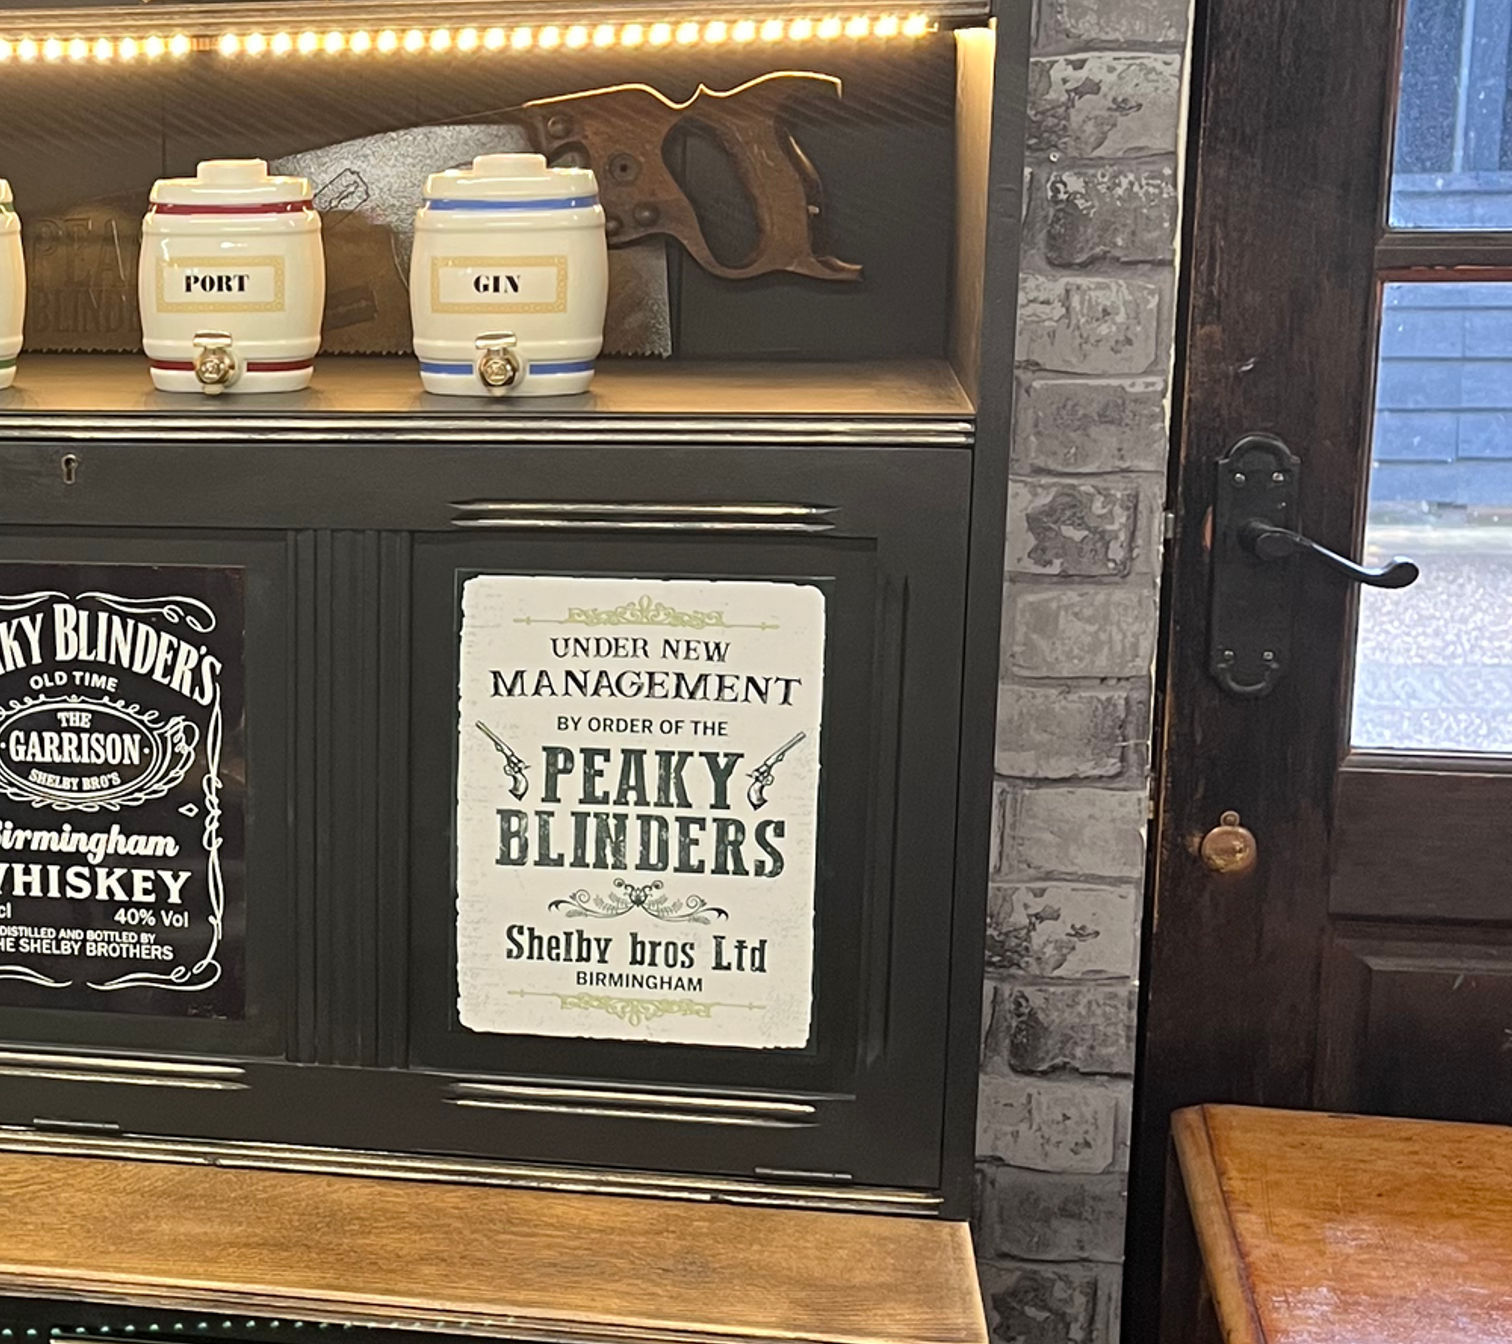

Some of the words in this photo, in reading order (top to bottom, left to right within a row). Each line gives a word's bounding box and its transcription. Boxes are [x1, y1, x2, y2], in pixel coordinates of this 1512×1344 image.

[184, 274, 250, 294] PORT
[473, 274, 522, 294] GIN
[53, 603, 222, 706] BLINDER'S
[550, 637, 649, 659] UNDER
[662, 639, 730, 663] NEW
[29, 671, 68, 690] OLD
[72, 671, 119, 693] TIME
[489, 669, 802, 706] MANAGEMENT
[57, 711, 92, 728] THE
[557, 716, 582, 731] BY
[588, 717, 653, 733] ORDER
[660, 719, 685, 734] OF
[690, 720, 728, 736] THE
[9, 731, 141, 765] GARRISON
[28, 768, 79, 790] SHELBY
[81, 771, 121, 791] BRO'S
[541, 745, 745, 810] PEAKY
[495, 808, 786, 878] BLINDERS
[114, 908, 156, 926] 40%
[160, 910, 189, 928] Vol
[0, 925, 56, 939] DISTILLED
[58, 928, 84, 940] AND
[87, 929, 138, 943] BOTTLED
[140, 932, 155, 944] BY
[19, 937, 82, 956] SHELBY
[86, 941, 174, 960] BROTHERS
[506, 924, 612, 964] Shelby
[629, 932, 695, 969] bros
[711, 935, 767, 973] Ltd
[576, 971, 704, 993] BIRMINGHAM
